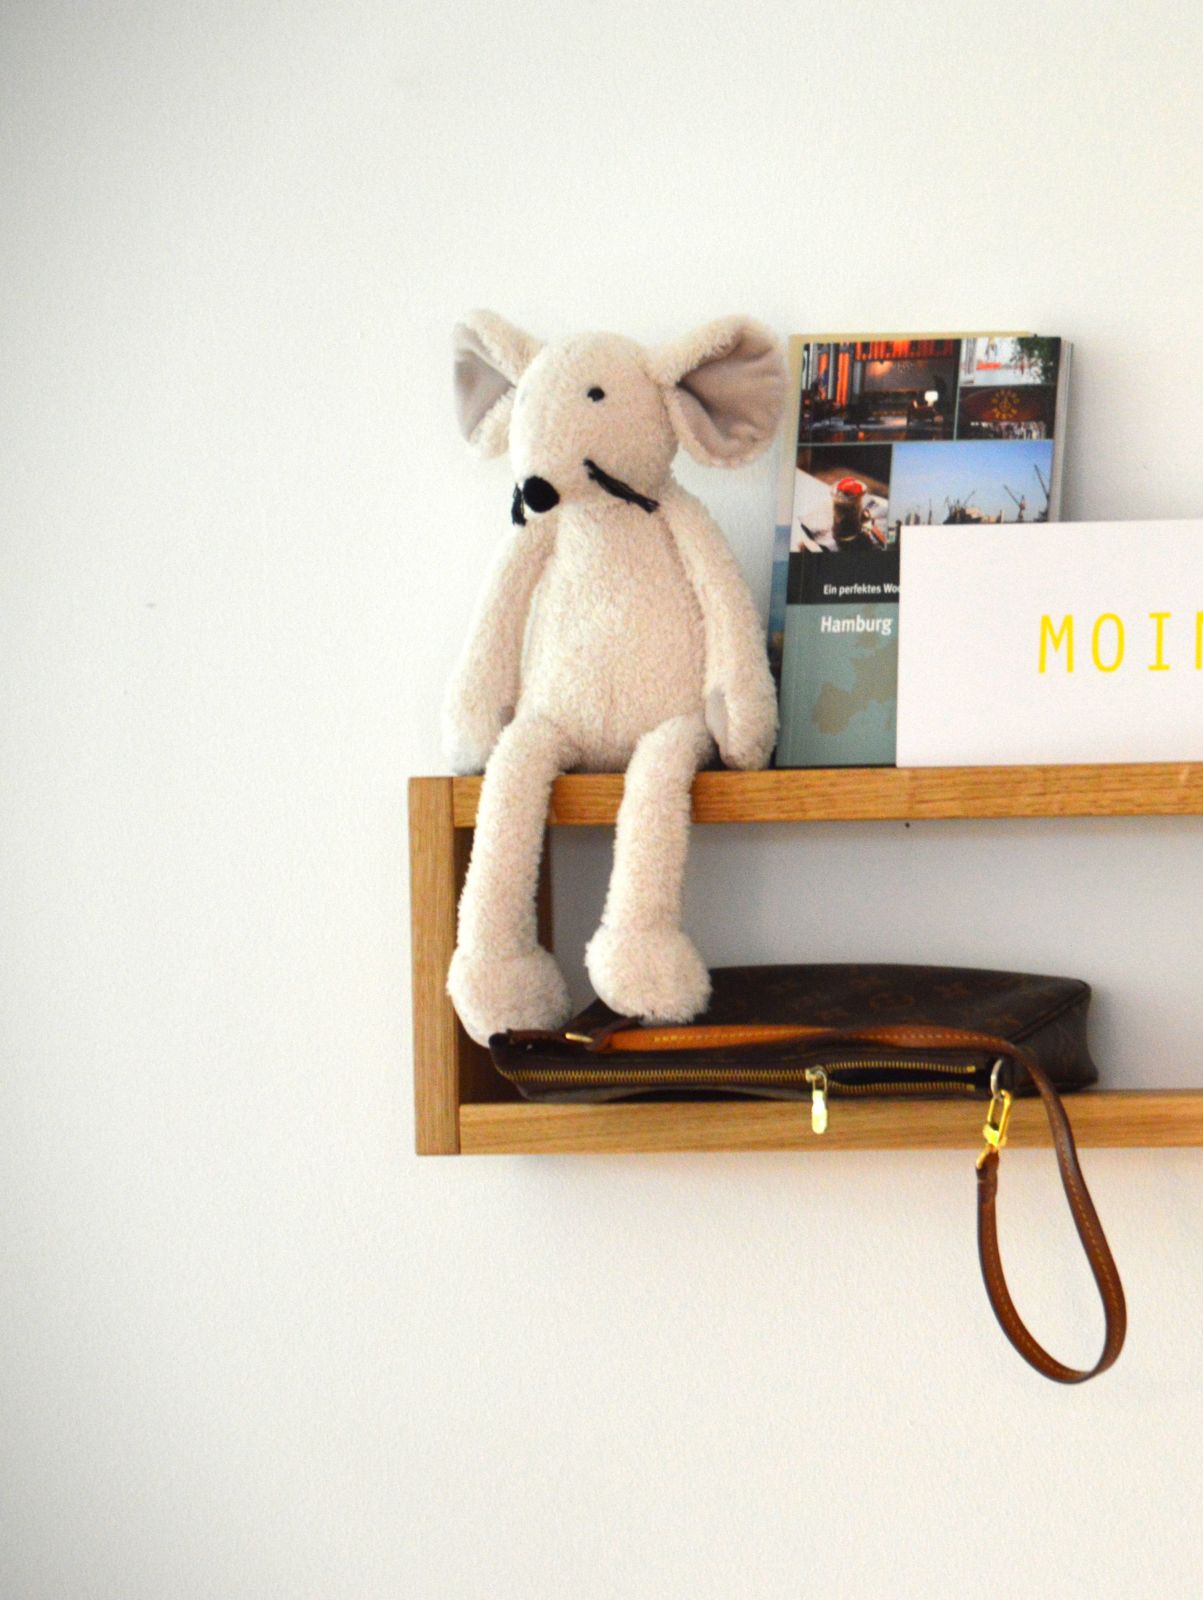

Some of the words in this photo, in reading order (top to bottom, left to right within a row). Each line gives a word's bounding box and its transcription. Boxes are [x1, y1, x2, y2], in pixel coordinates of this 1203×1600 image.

[823, 584, 837, 595] Ein
[838, 582, 882, 597] perfektes
[820, 614, 894, 636] Hamburg
